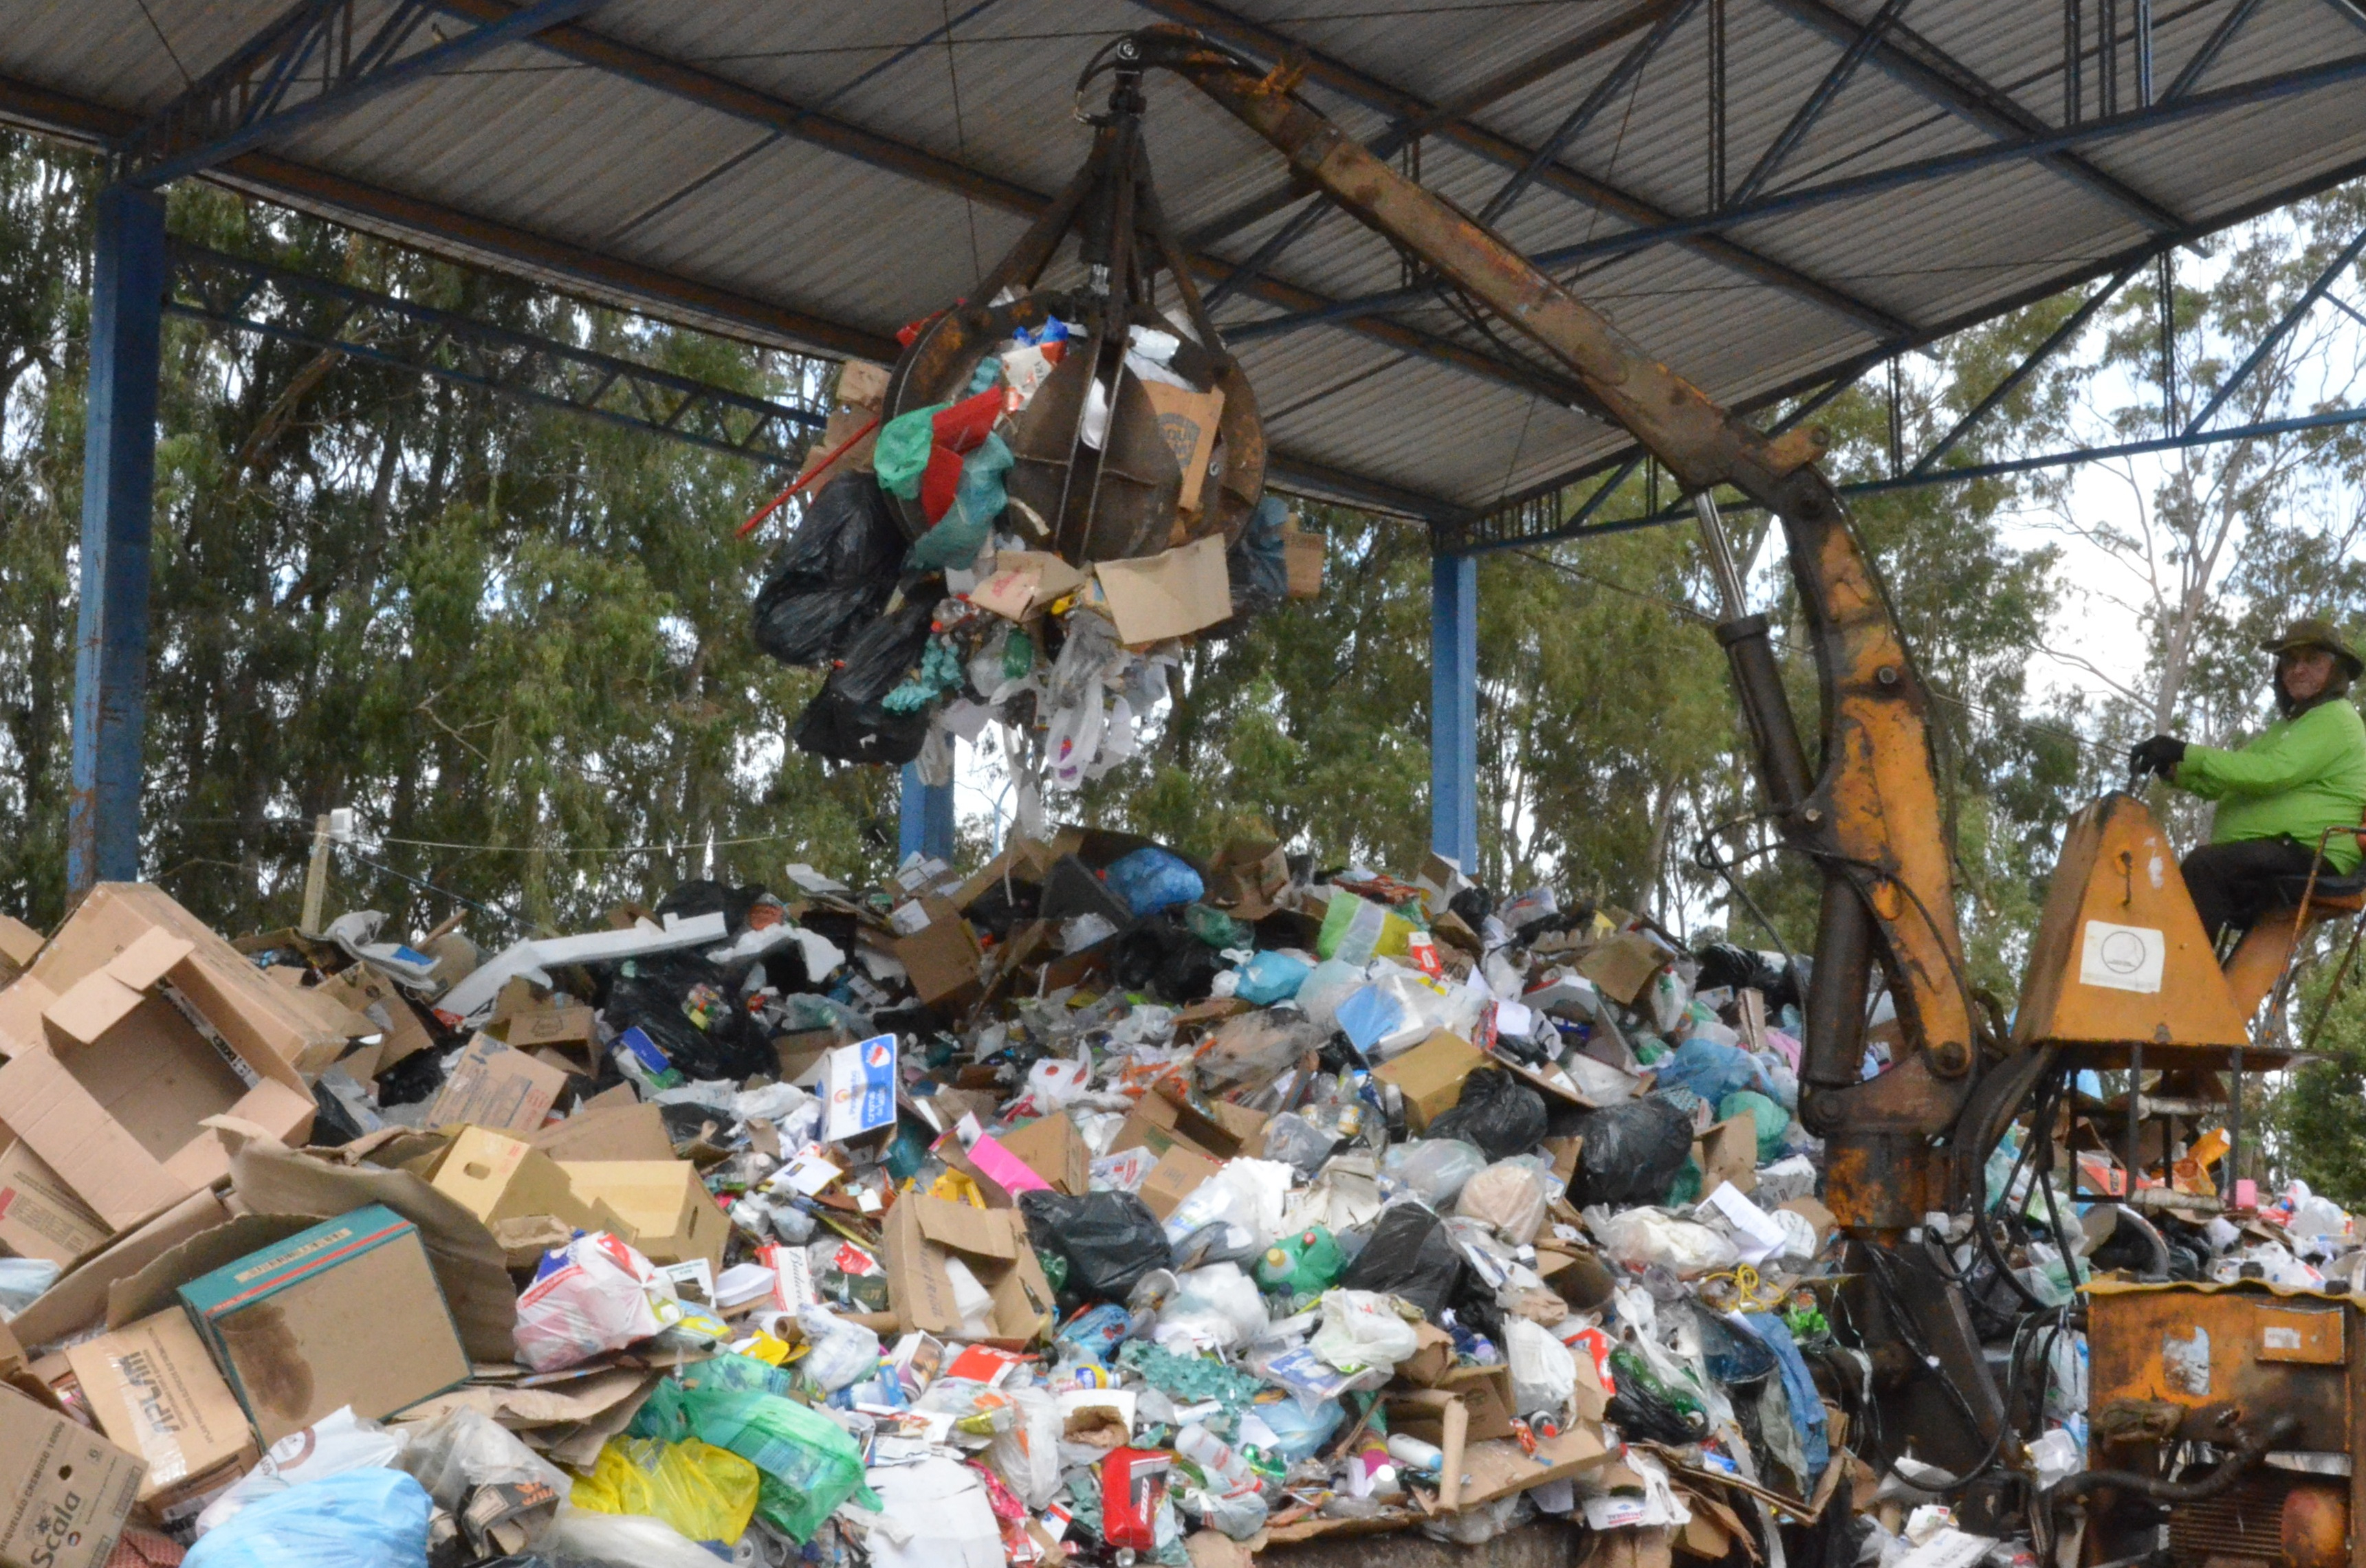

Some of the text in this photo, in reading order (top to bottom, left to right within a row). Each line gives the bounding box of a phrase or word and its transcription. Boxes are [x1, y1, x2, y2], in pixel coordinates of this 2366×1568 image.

[789, 1250, 805, 1303] Budwei
[119, 1351, 180, 1433] APLAM
[25, 1450, 51, 1497] CREMOSO
[30, 1490, 81, 1568] Scala
